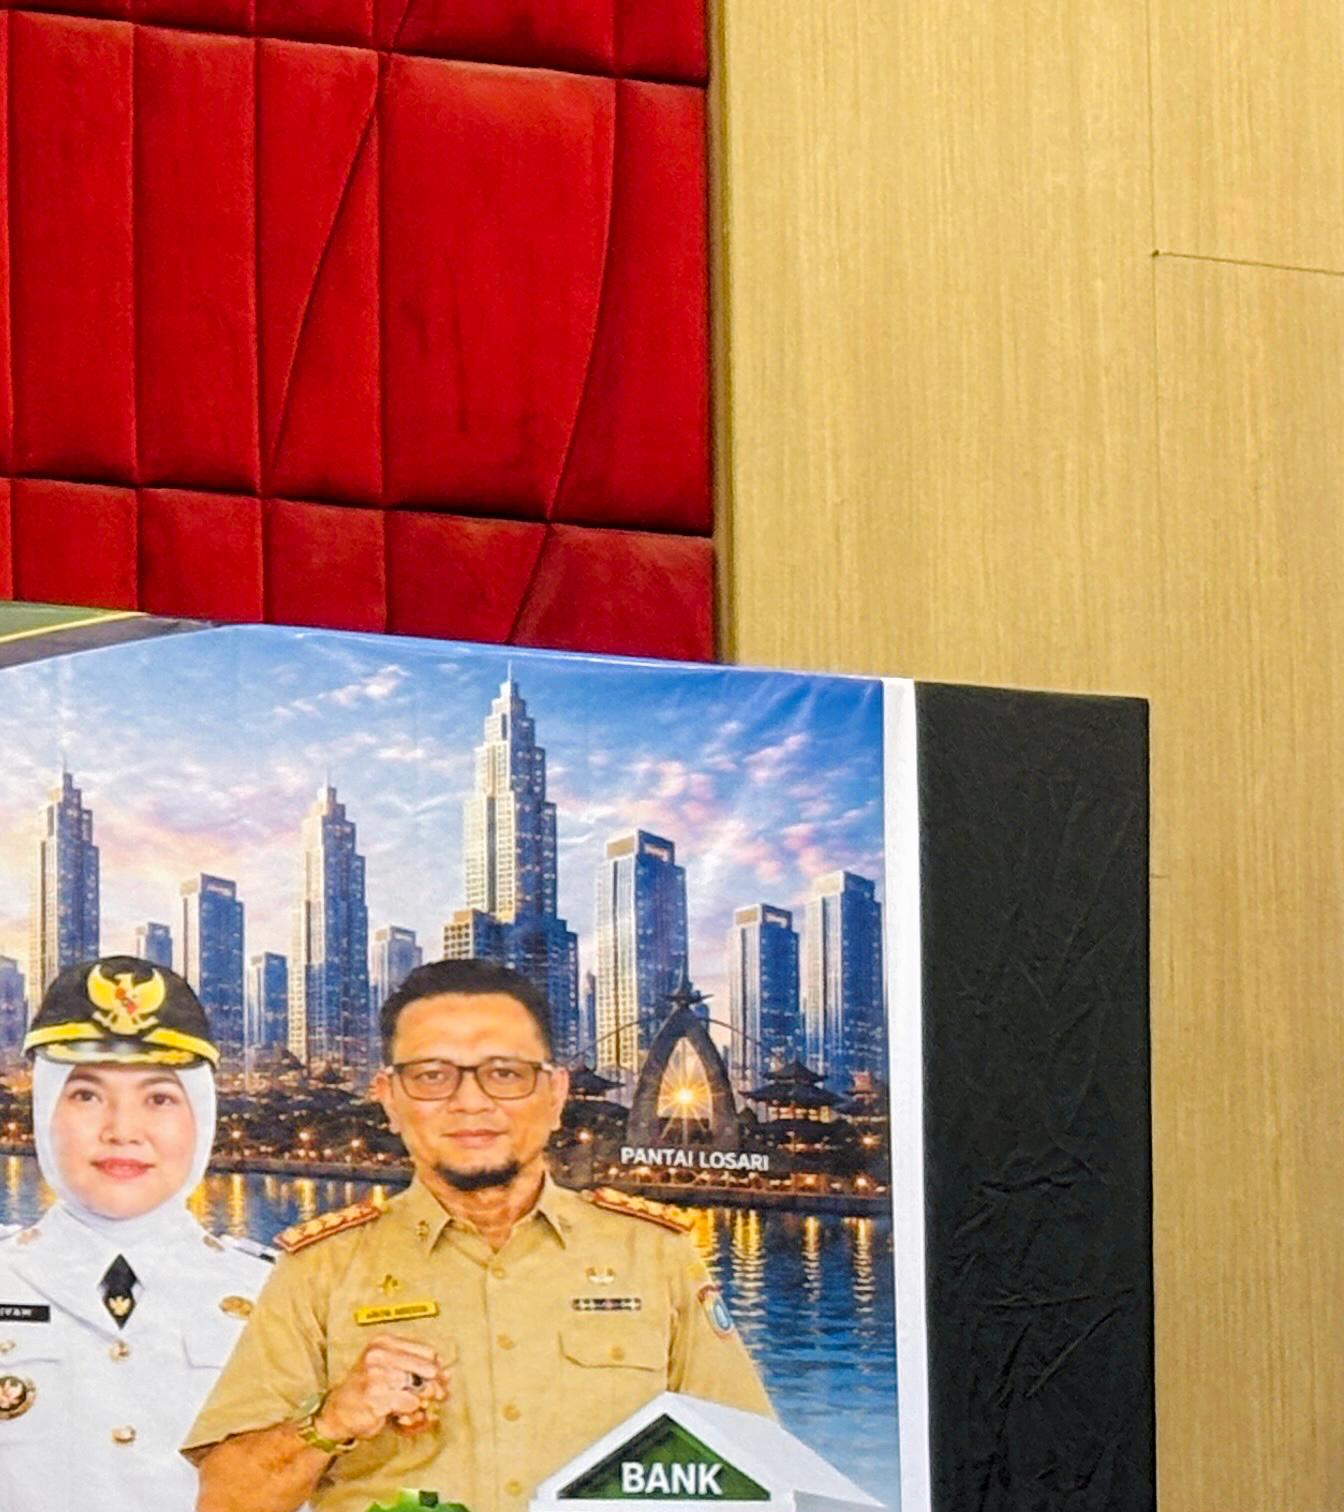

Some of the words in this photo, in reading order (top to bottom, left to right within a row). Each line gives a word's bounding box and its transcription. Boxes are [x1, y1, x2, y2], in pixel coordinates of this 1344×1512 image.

[620, 1145, 694, 1169] PANTAI
[697, 1151, 770, 1173] LOSARI
[621, 1461, 723, 1496] BANK
